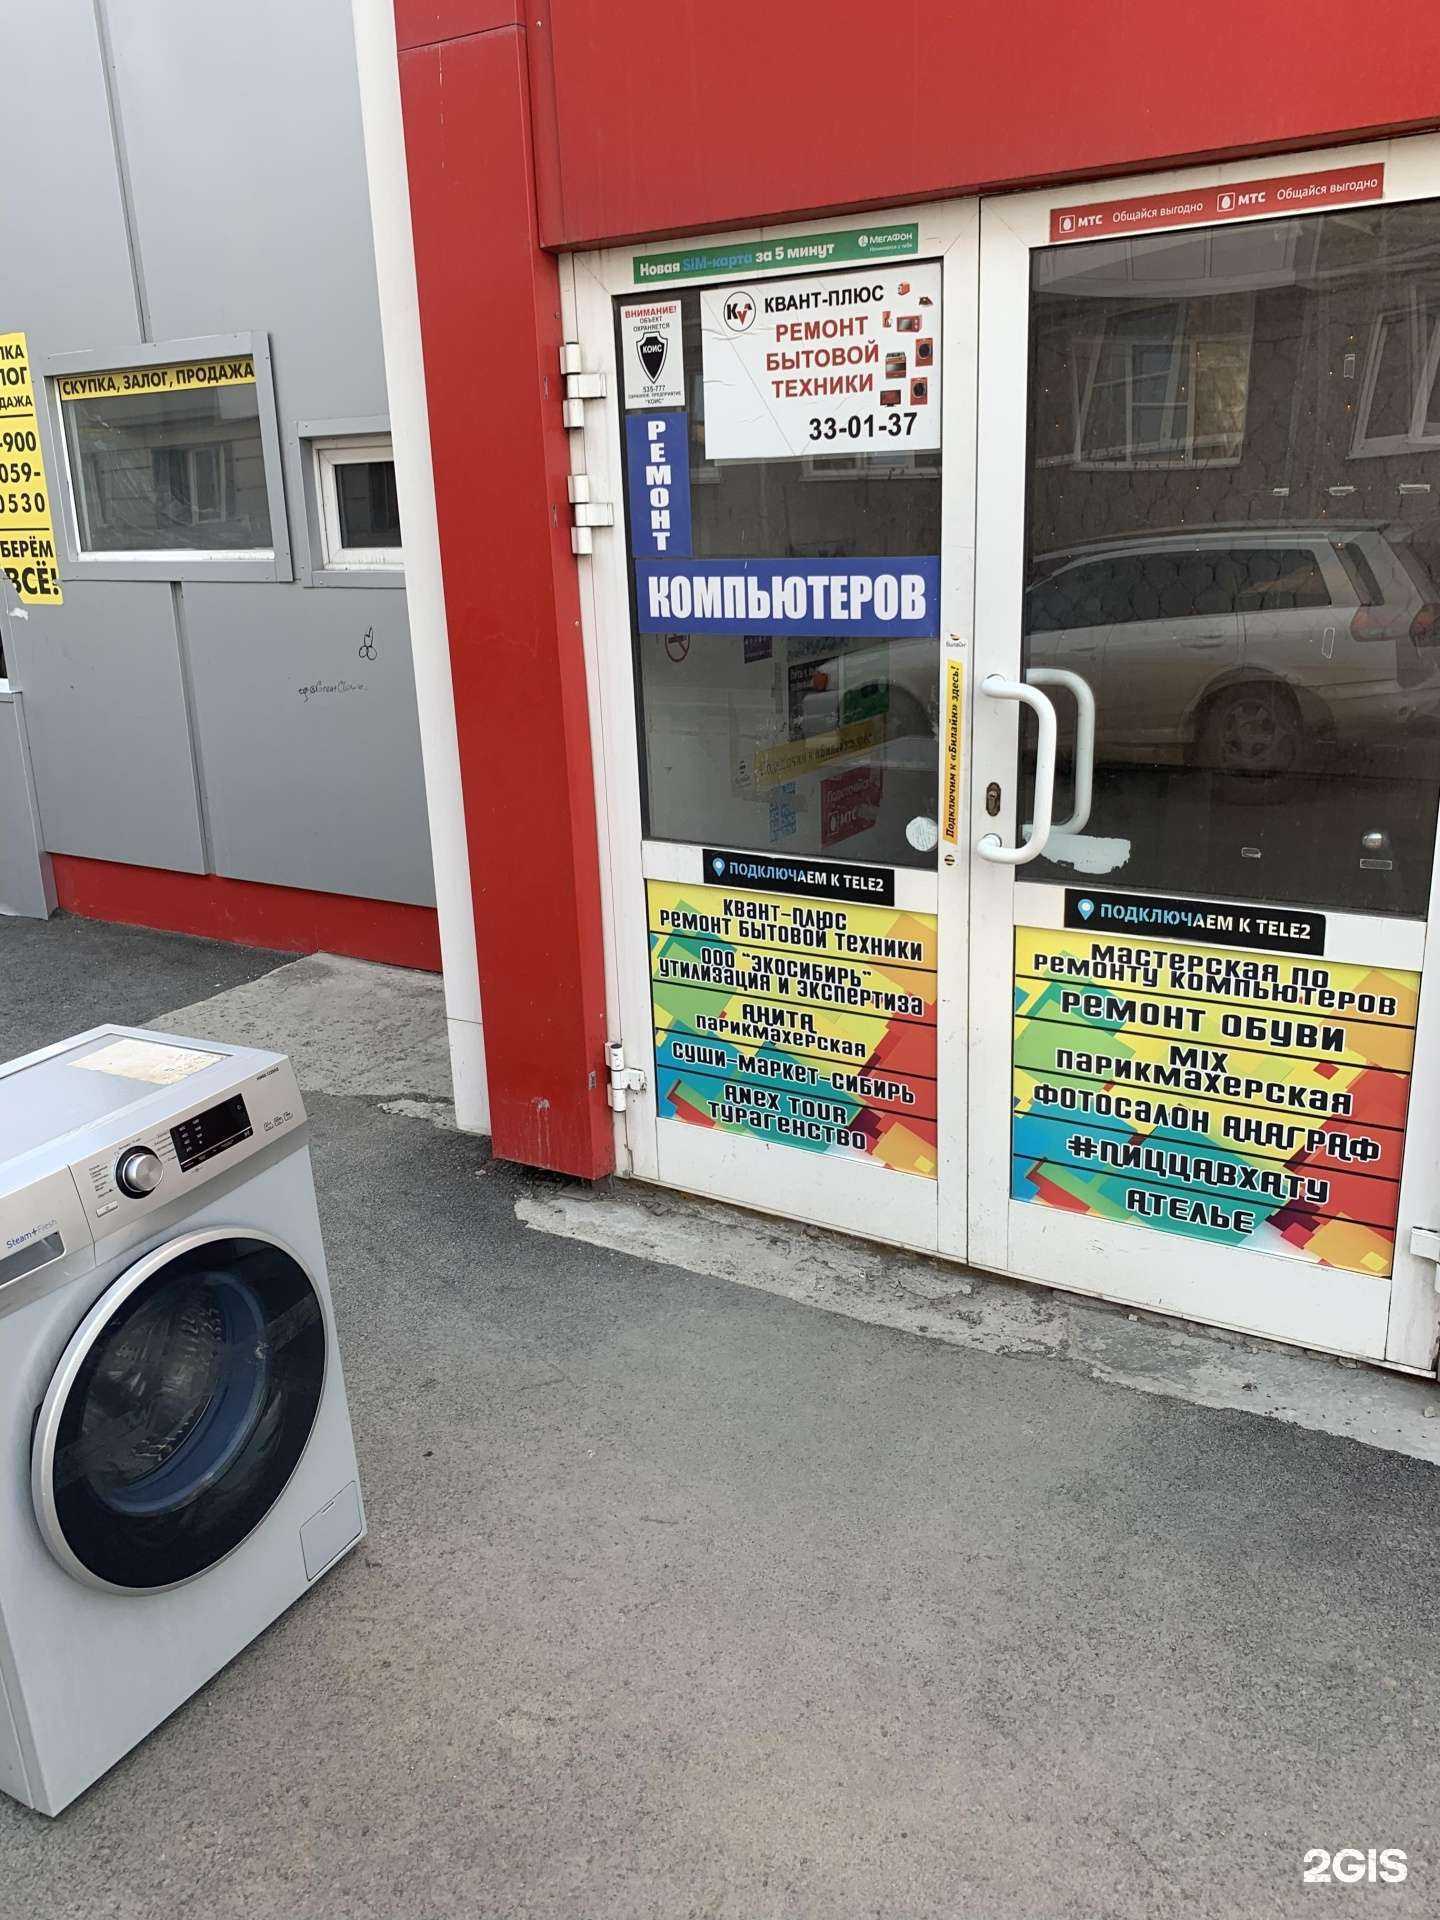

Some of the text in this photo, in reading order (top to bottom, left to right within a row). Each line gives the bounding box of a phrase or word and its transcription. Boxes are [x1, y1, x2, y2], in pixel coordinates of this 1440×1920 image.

[1238, 178, 1378, 205] МТС Общайся выгодно
[1077, 202, 1203, 227] МТС Общайся выгодно
[639, 242, 835, 276] Новая SIM-карта за 5 минут
[624, 305, 677, 318] ВНИМАНИЕ!
[764, 285, 885, 314] КВАНТ-ПЛЮС
[776, 316, 868, 342] РЕМОНТ
[766, 339, 879, 371] БЫТОВОЙ
[62, 363, 255, 395] СКУПКА, ЗАЛОГ, ПРОДАЖА
[772, 373, 873, 398] ТЕХНИКИ
[808, 411, 918, 441] 33-01-37
[645, 420, 672, 551] РЕМОНТ
[648, 574, 927, 621] КОМПЬЮТЕРОВ
[950, 665, 960, 702] здесь!
[949, 763, 957, 771] к
[945, 773, 957, 838] Подключим
[729, 861, 885, 892] ПОДКЛЮЧАЕМ К TELE2
[1100, 902, 1311, 940] ПОДКЛЮЧАЕМ К TELE2
[701, 948, 735, 968] ООО
[778, 977, 789, 995] И
[742, 1003, 817, 1034] АНИТА
[1126, 1187, 1256, 1235] АТЕЛЬЕ
